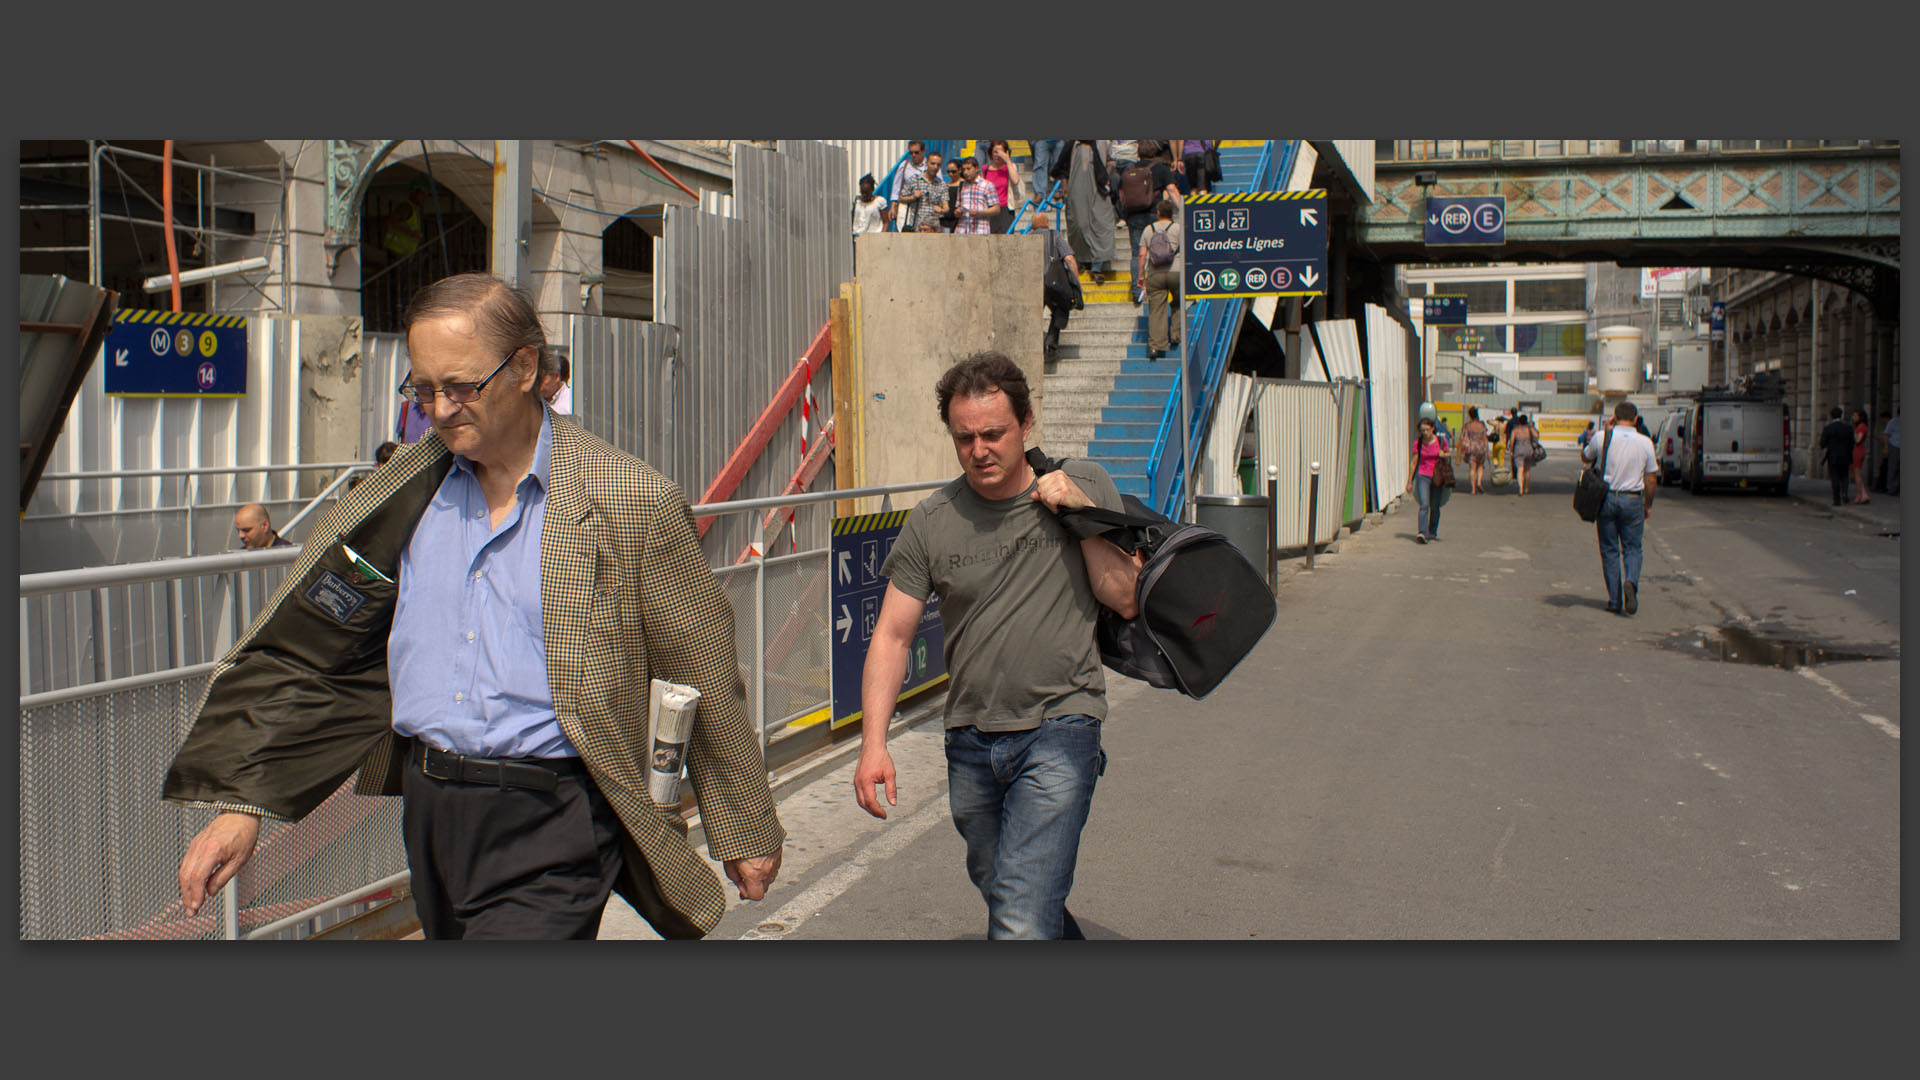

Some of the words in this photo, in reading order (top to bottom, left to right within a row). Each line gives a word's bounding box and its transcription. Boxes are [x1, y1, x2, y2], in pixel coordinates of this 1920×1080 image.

[1197, 218, 1212, 230] 13
[1231, 217, 1246, 229] 27
[1445, 212, 1467, 225] RER
[1483, 211, 1494, 226] E
[1193, 238, 1244, 252] Grandes
[1245, 237, 1285, 252] Lignes
[1198, 274, 1211, 286] M
[1221, 272, 1238, 286] 12
[1248, 274, 1264, 284] RER
[1277, 272, 1285, 284] E
[155, 334, 166, 349] M
[180, 335, 189, 352] 3
[204, 336, 212, 352] 9
[199, 367, 214, 384] 14
[865, 613, 876, 635] 13
[915, 645, 927, 669] 12
